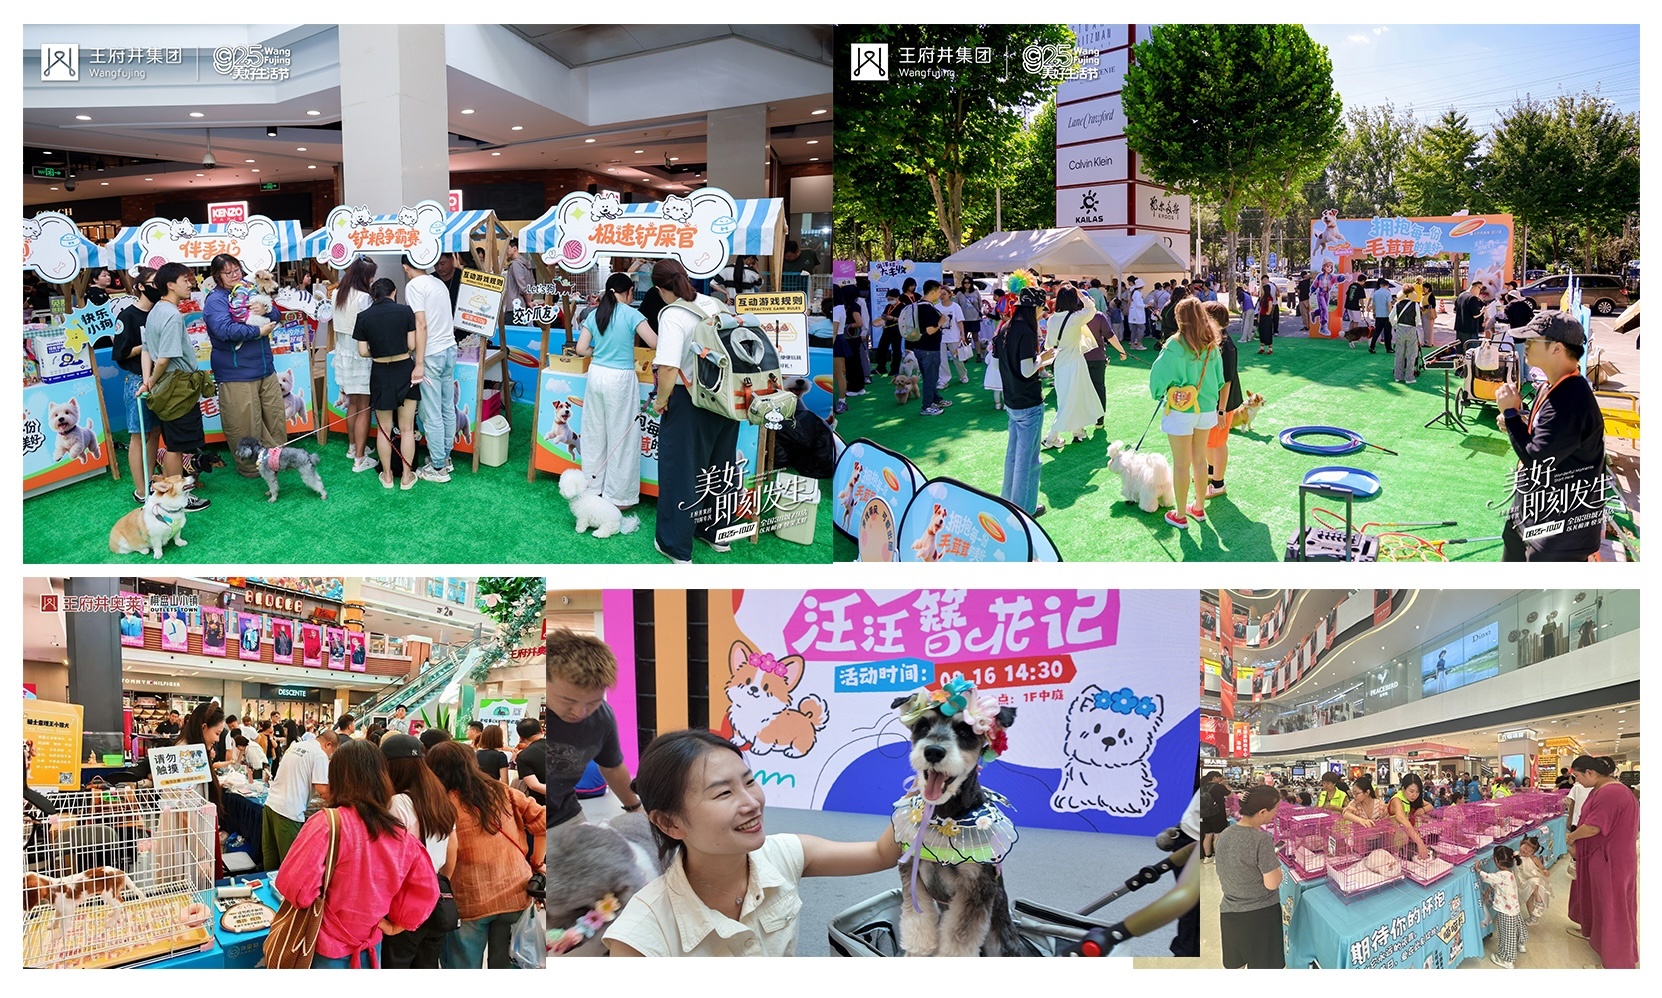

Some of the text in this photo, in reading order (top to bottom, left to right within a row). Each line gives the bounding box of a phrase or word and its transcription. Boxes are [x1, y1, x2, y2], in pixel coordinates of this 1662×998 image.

[1077, 28, 1112, 47] EITZMAN
[1067, 115, 1085, 129] Lane
[1068, 156, 1113, 171] Calvin Klein
[212, 206, 243, 218] KENZO
[1075, 215, 1104, 224] KAILAS
[588, 221, 699, 250] 极速铲屎官
[1368, 215, 1443, 241] 拥抱每一份
[347, 227, 422, 249] 铲粮争霸赛
[178, 239, 241, 259] 伴手礼
[1362, 236, 1443, 258] 毛茸茸的美好
[462, 269, 504, 287] 互动游戏规则
[738, 295, 803, 307] 互动游戏规则
[81, 309, 109, 325] 快乐
[88, 321, 114, 335] 小狗
[791, 587, 1106, 657] 汪汪簪花记
[839, 664, 928, 686] 活动时间：
[1004, 660, 1063, 682] 14:30
[278, 688, 307, 697] DESCENTE
[1023, 690, 1064, 702] 1F中庭
[1370, 681, 1399, 697] PEACEBIRD
[154, 753, 177, 765] 请勿
[156, 764, 180, 776] 触摸
[1350, 890, 1446, 966] 期待你的怀抱
